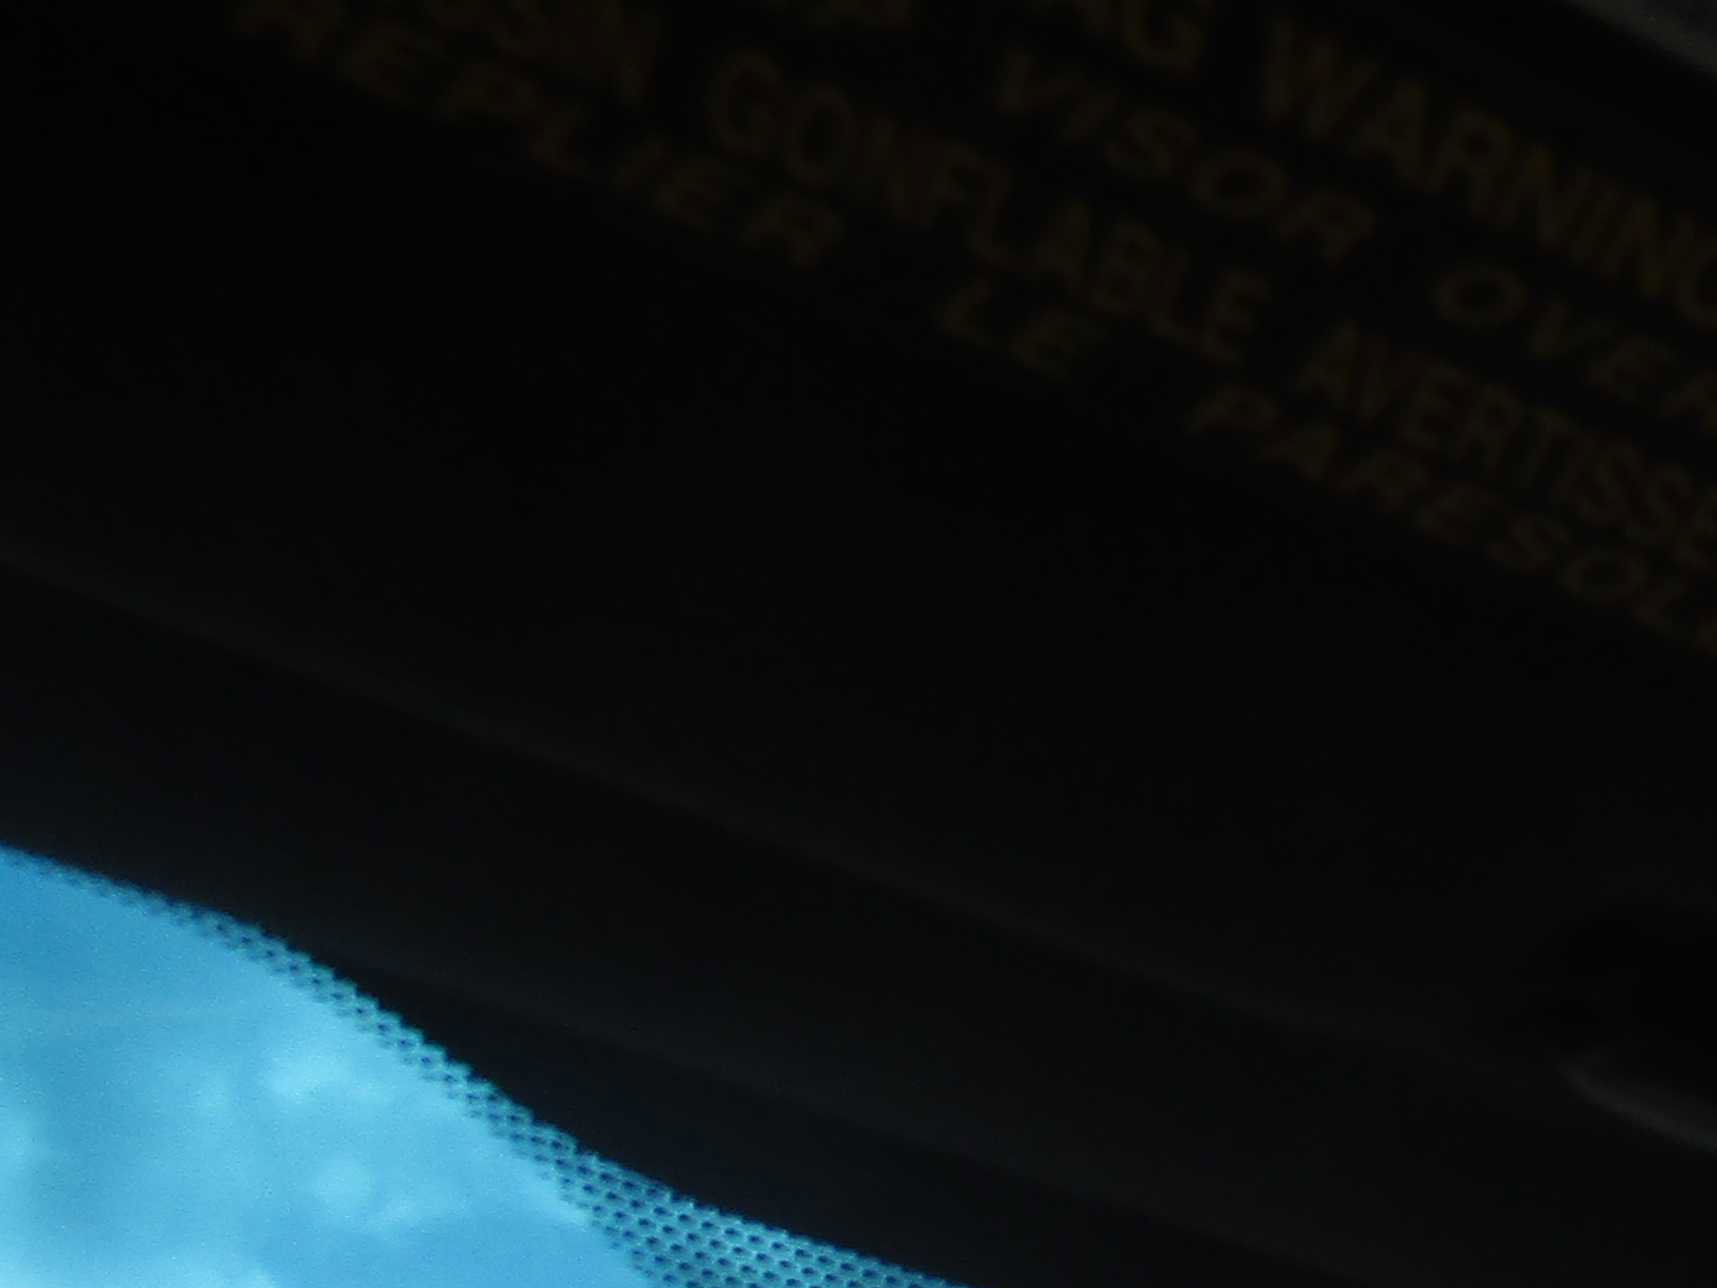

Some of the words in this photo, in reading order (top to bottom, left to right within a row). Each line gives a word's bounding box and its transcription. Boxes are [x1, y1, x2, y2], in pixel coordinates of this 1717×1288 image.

[705, 45, 1270, 368] GONFLABLE
[995, 42, 1378, 272] VISOR
[930, 275, 1105, 380] LE
